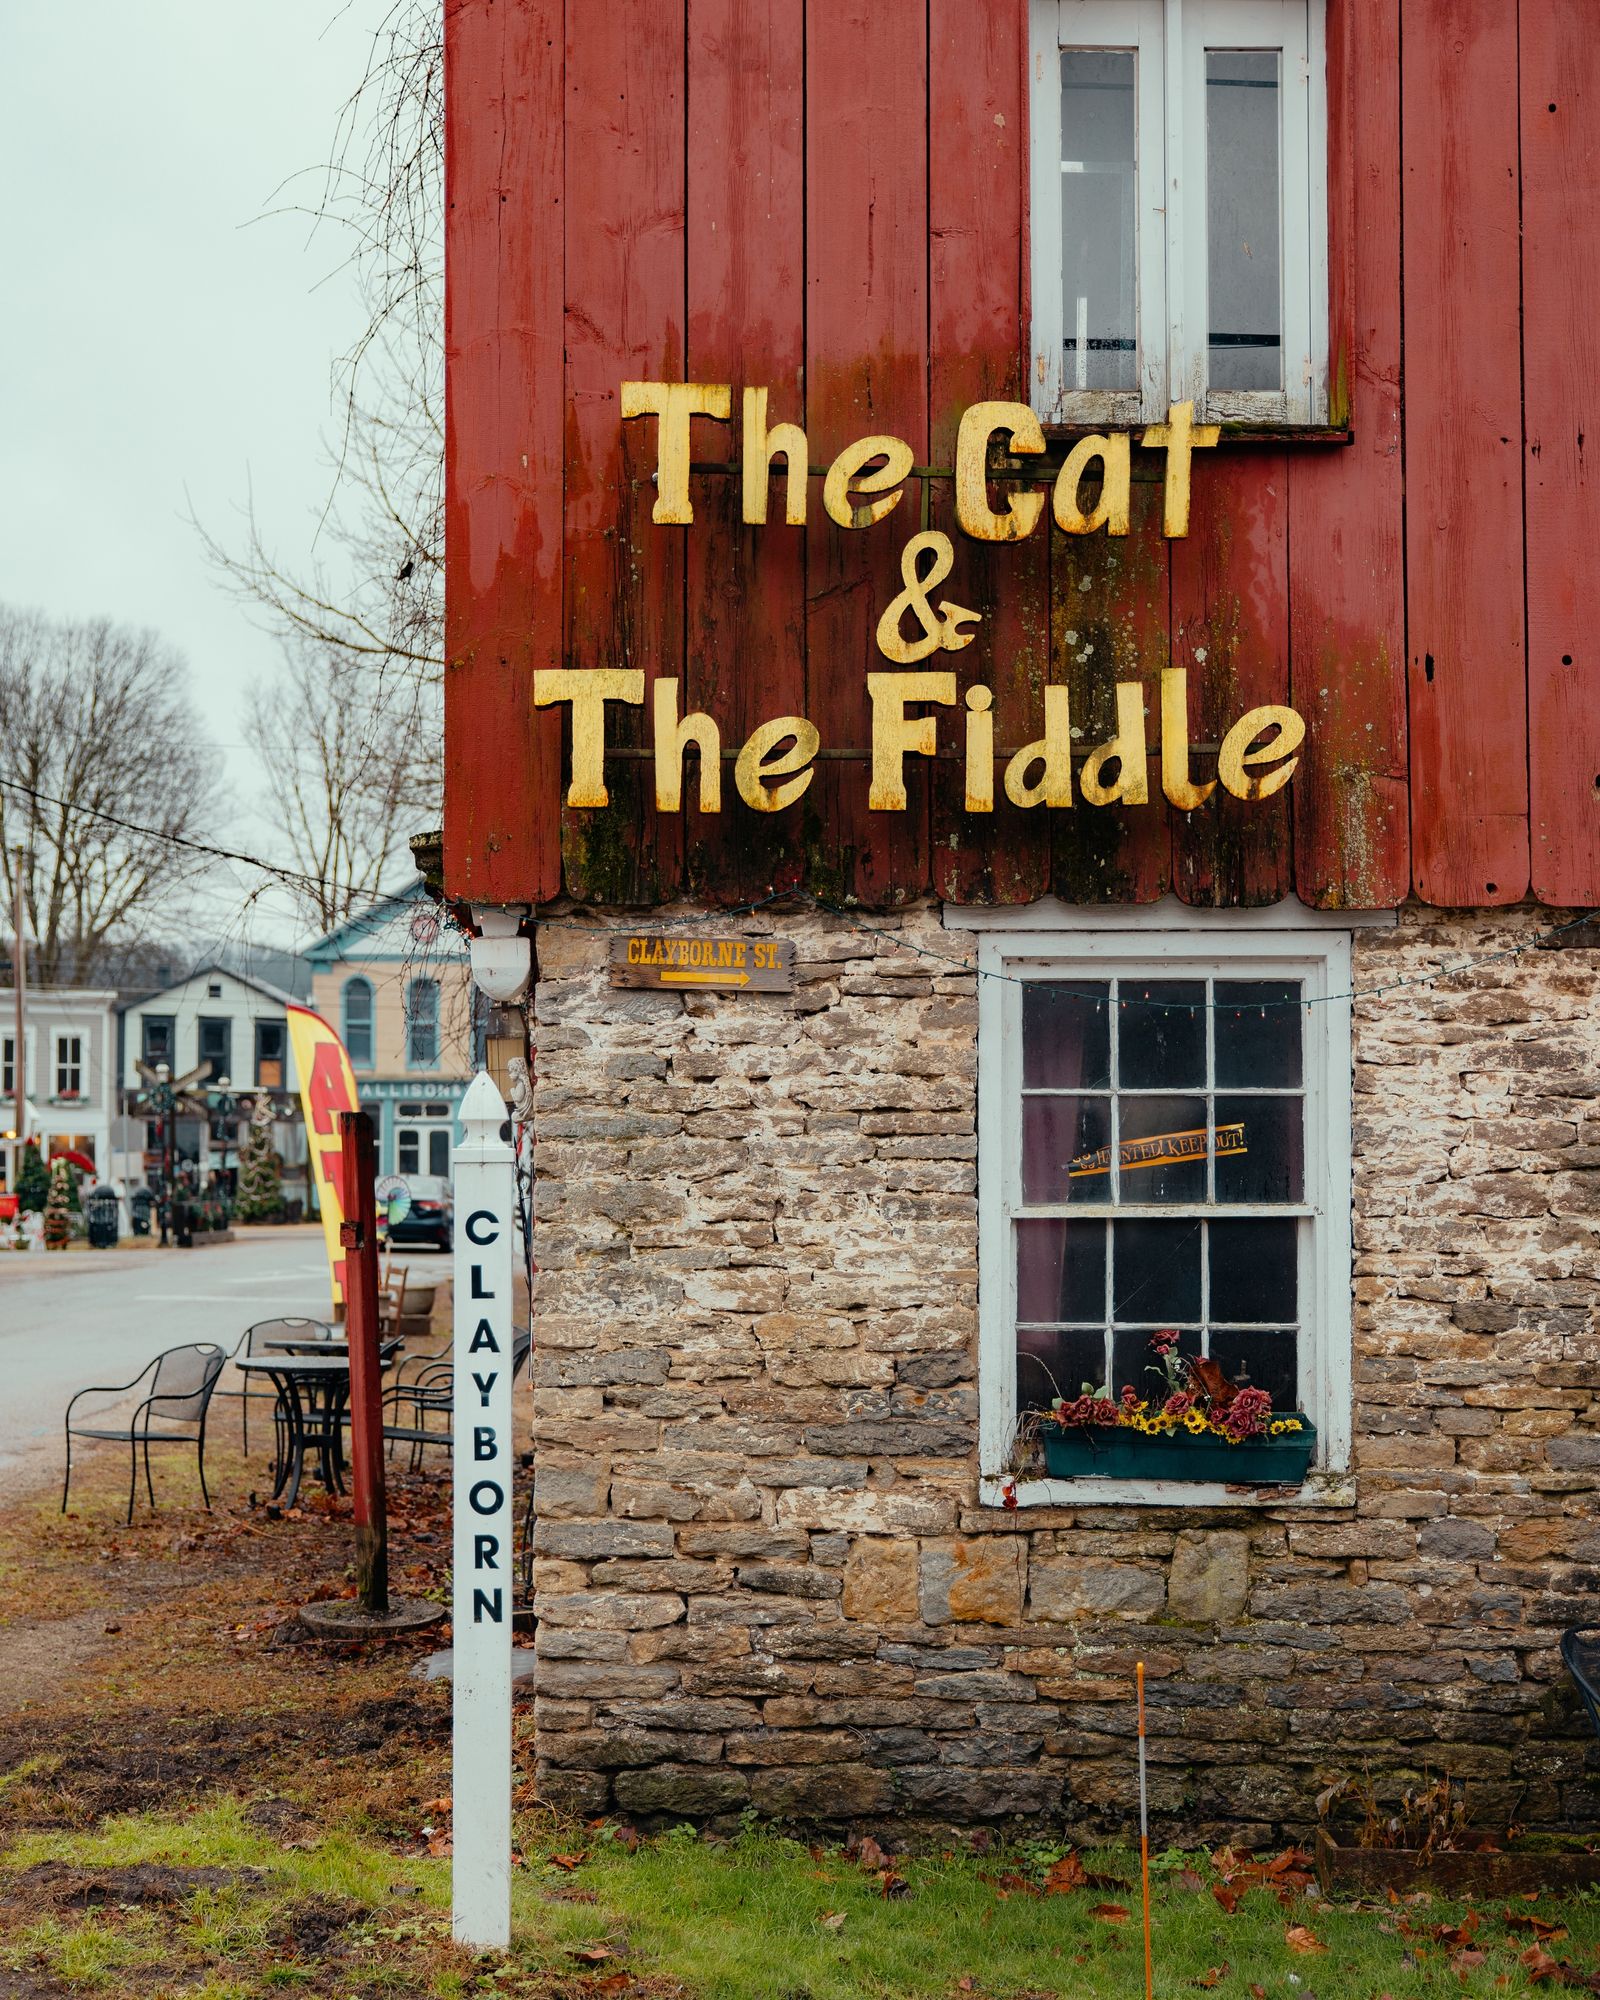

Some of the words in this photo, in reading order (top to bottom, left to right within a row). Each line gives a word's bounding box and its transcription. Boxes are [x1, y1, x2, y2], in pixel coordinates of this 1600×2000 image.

[621, 381, 914, 529] The
[956, 400, 1221, 541] Cat
[876, 530, 982, 664] &
[533, 669, 820, 813] The
[867, 667, 1306, 812] Fiddle
[627, 937, 746, 968] CLAYBORNE
[753, 943, 782, 969] ST.
[1096, 1140, 1165, 1166] HANTED!
[1168, 1134, 1208, 1157] KEEP
[465, 1210, 505, 1624] CLAYBORN
